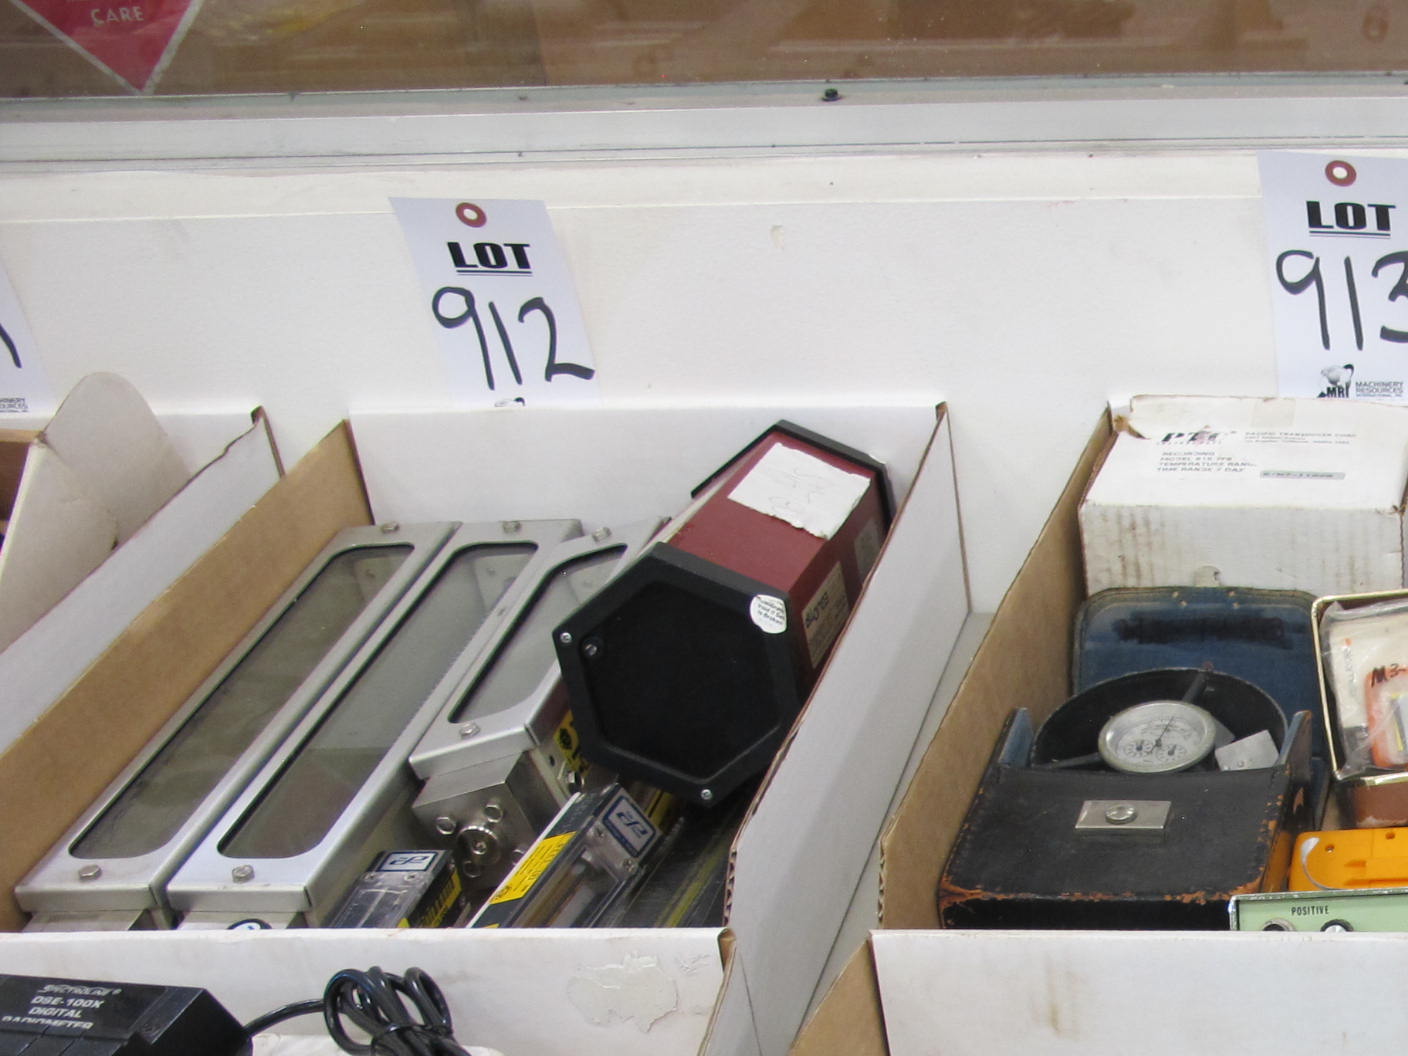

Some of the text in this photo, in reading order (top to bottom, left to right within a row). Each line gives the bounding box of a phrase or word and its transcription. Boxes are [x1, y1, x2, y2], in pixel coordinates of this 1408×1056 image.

[91, 6, 144, 25] CARE
[1306, 201, 1396, 231] LOT
[447, 242, 531, 269] LOT
[432, 286, 595, 390] 912
[1326, 384, 1349, 398] MRI
[1291, 905, 1329, 916] POSITIVE
[31, 996, 104, 1009] DSE-100X
[28, 1006, 83, 1018] DIGITAL
